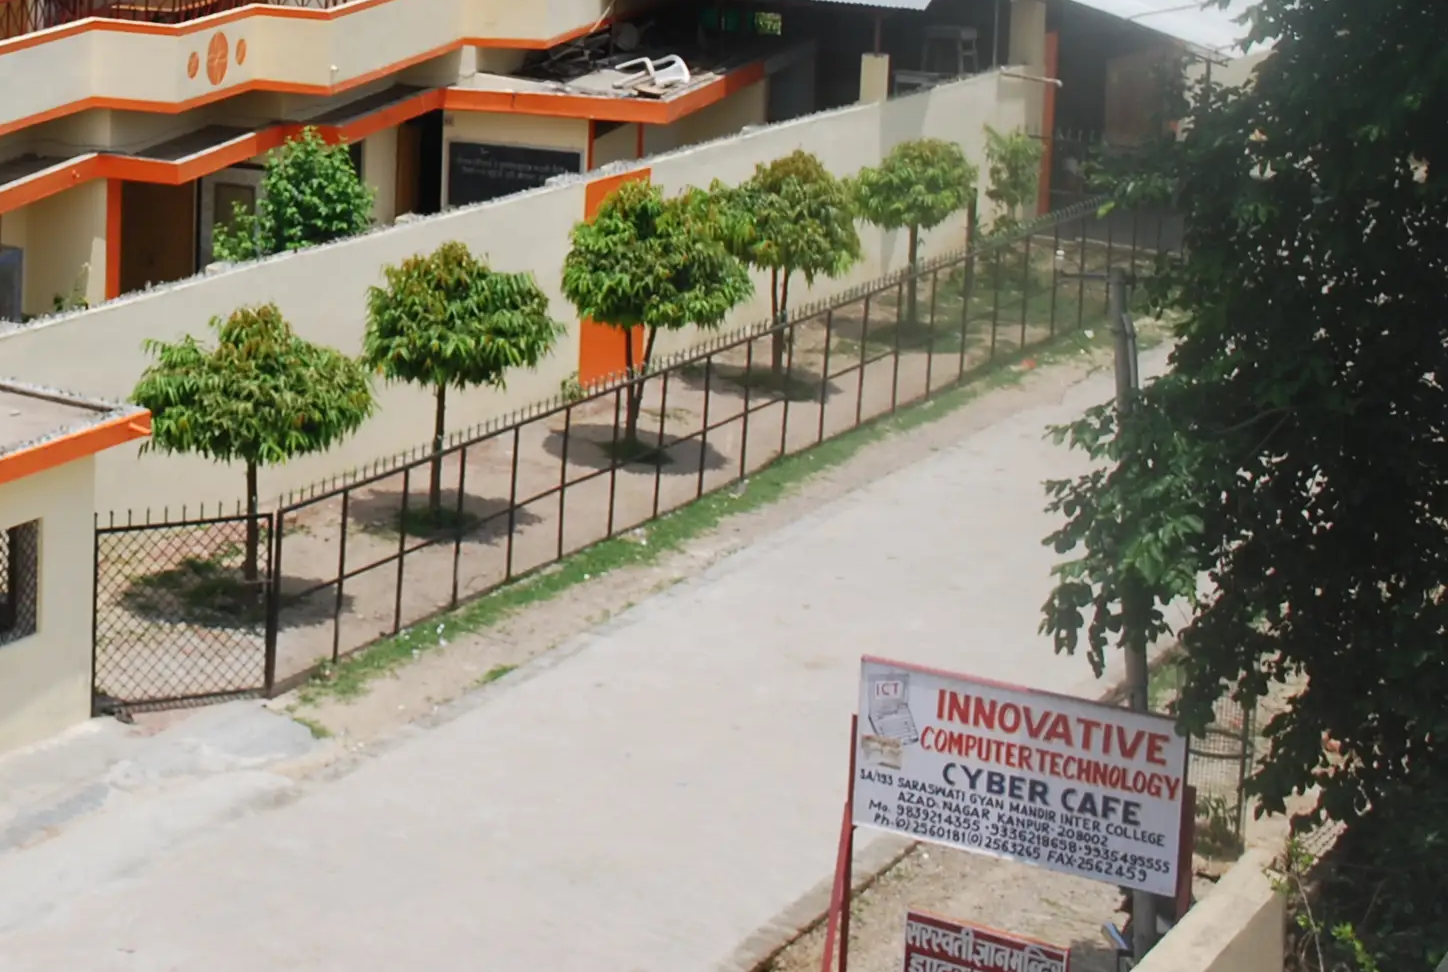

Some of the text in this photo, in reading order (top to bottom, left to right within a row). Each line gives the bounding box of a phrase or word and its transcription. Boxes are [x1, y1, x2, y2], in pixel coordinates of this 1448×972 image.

[875, 680, 901, 697] ICT
[936, 687, 1171, 767] INNOVATIVE
[920, 725, 1182, 802] COMPUTER TECHNOLOGY
[896, 804, 981, 832] 9839214355
[897, 778, 966, 802] SARASWATI
[969, 793, 1004, 810] GYAN
[1009, 801, 1057, 824] MANDIR
[1060, 813, 1101, 832] INTER
[1105, 823, 1166, 847] COLLEGE
[942, 762, 1143, 826] CYBER CAFE
[942, 802, 991, 821] NAGAR
[1057, 825, 1109, 847] 208002
[907, 921, 974, 962] सरस्वती
